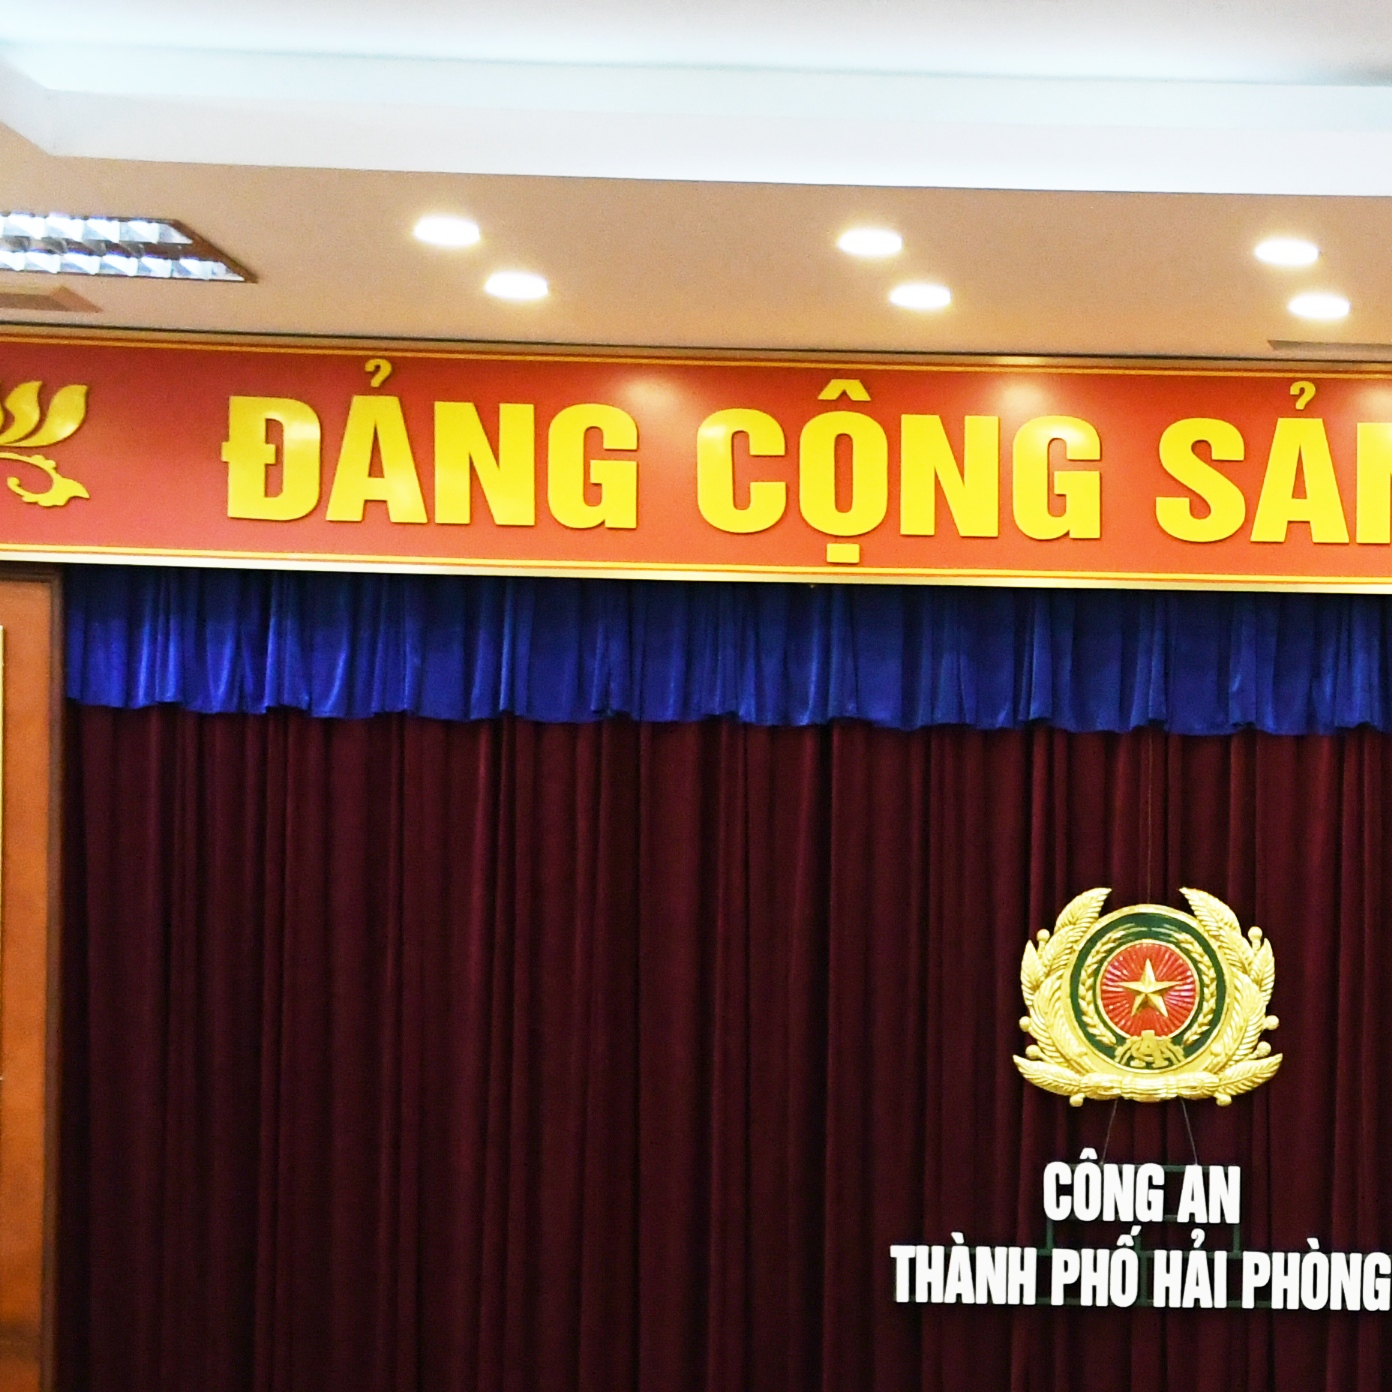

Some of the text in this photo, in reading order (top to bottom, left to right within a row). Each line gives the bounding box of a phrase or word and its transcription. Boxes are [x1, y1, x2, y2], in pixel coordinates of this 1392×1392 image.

[222, 359, 638, 530] ĐẢNG
[695, 378, 1102, 563] CỘNG
[1043, 1147, 1241, 1224] CÔNG AN
[889, 1225, 1392, 1312] THÀNH PHỐ HẢI PHÒNG
